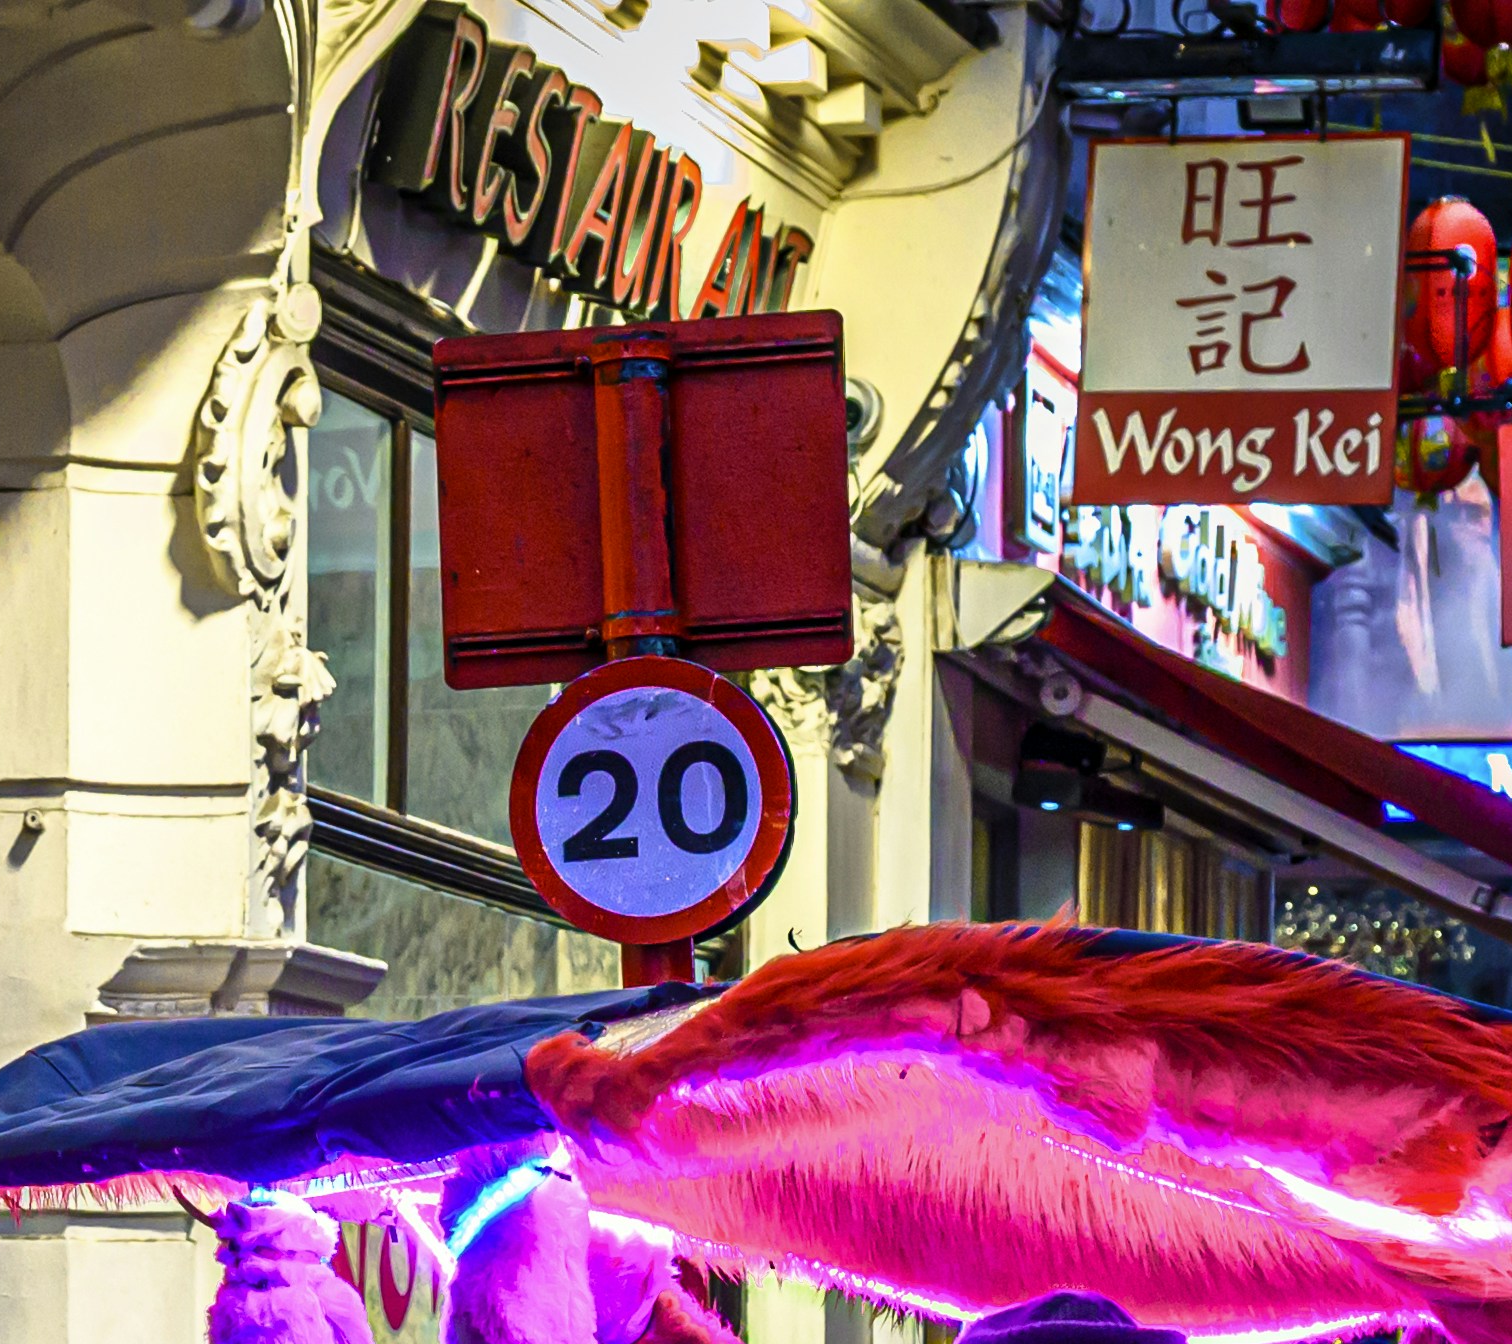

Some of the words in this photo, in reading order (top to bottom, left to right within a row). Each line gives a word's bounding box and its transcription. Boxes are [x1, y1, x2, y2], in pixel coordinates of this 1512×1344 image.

[420, 8, 815, 322] RESTAURANT
[1175, 155, 1313, 375] 旺記
[1091, 407, 1275, 493] Wong
[1293, 407, 1384, 477] Kei
[557, 740, 749, 864] 20
